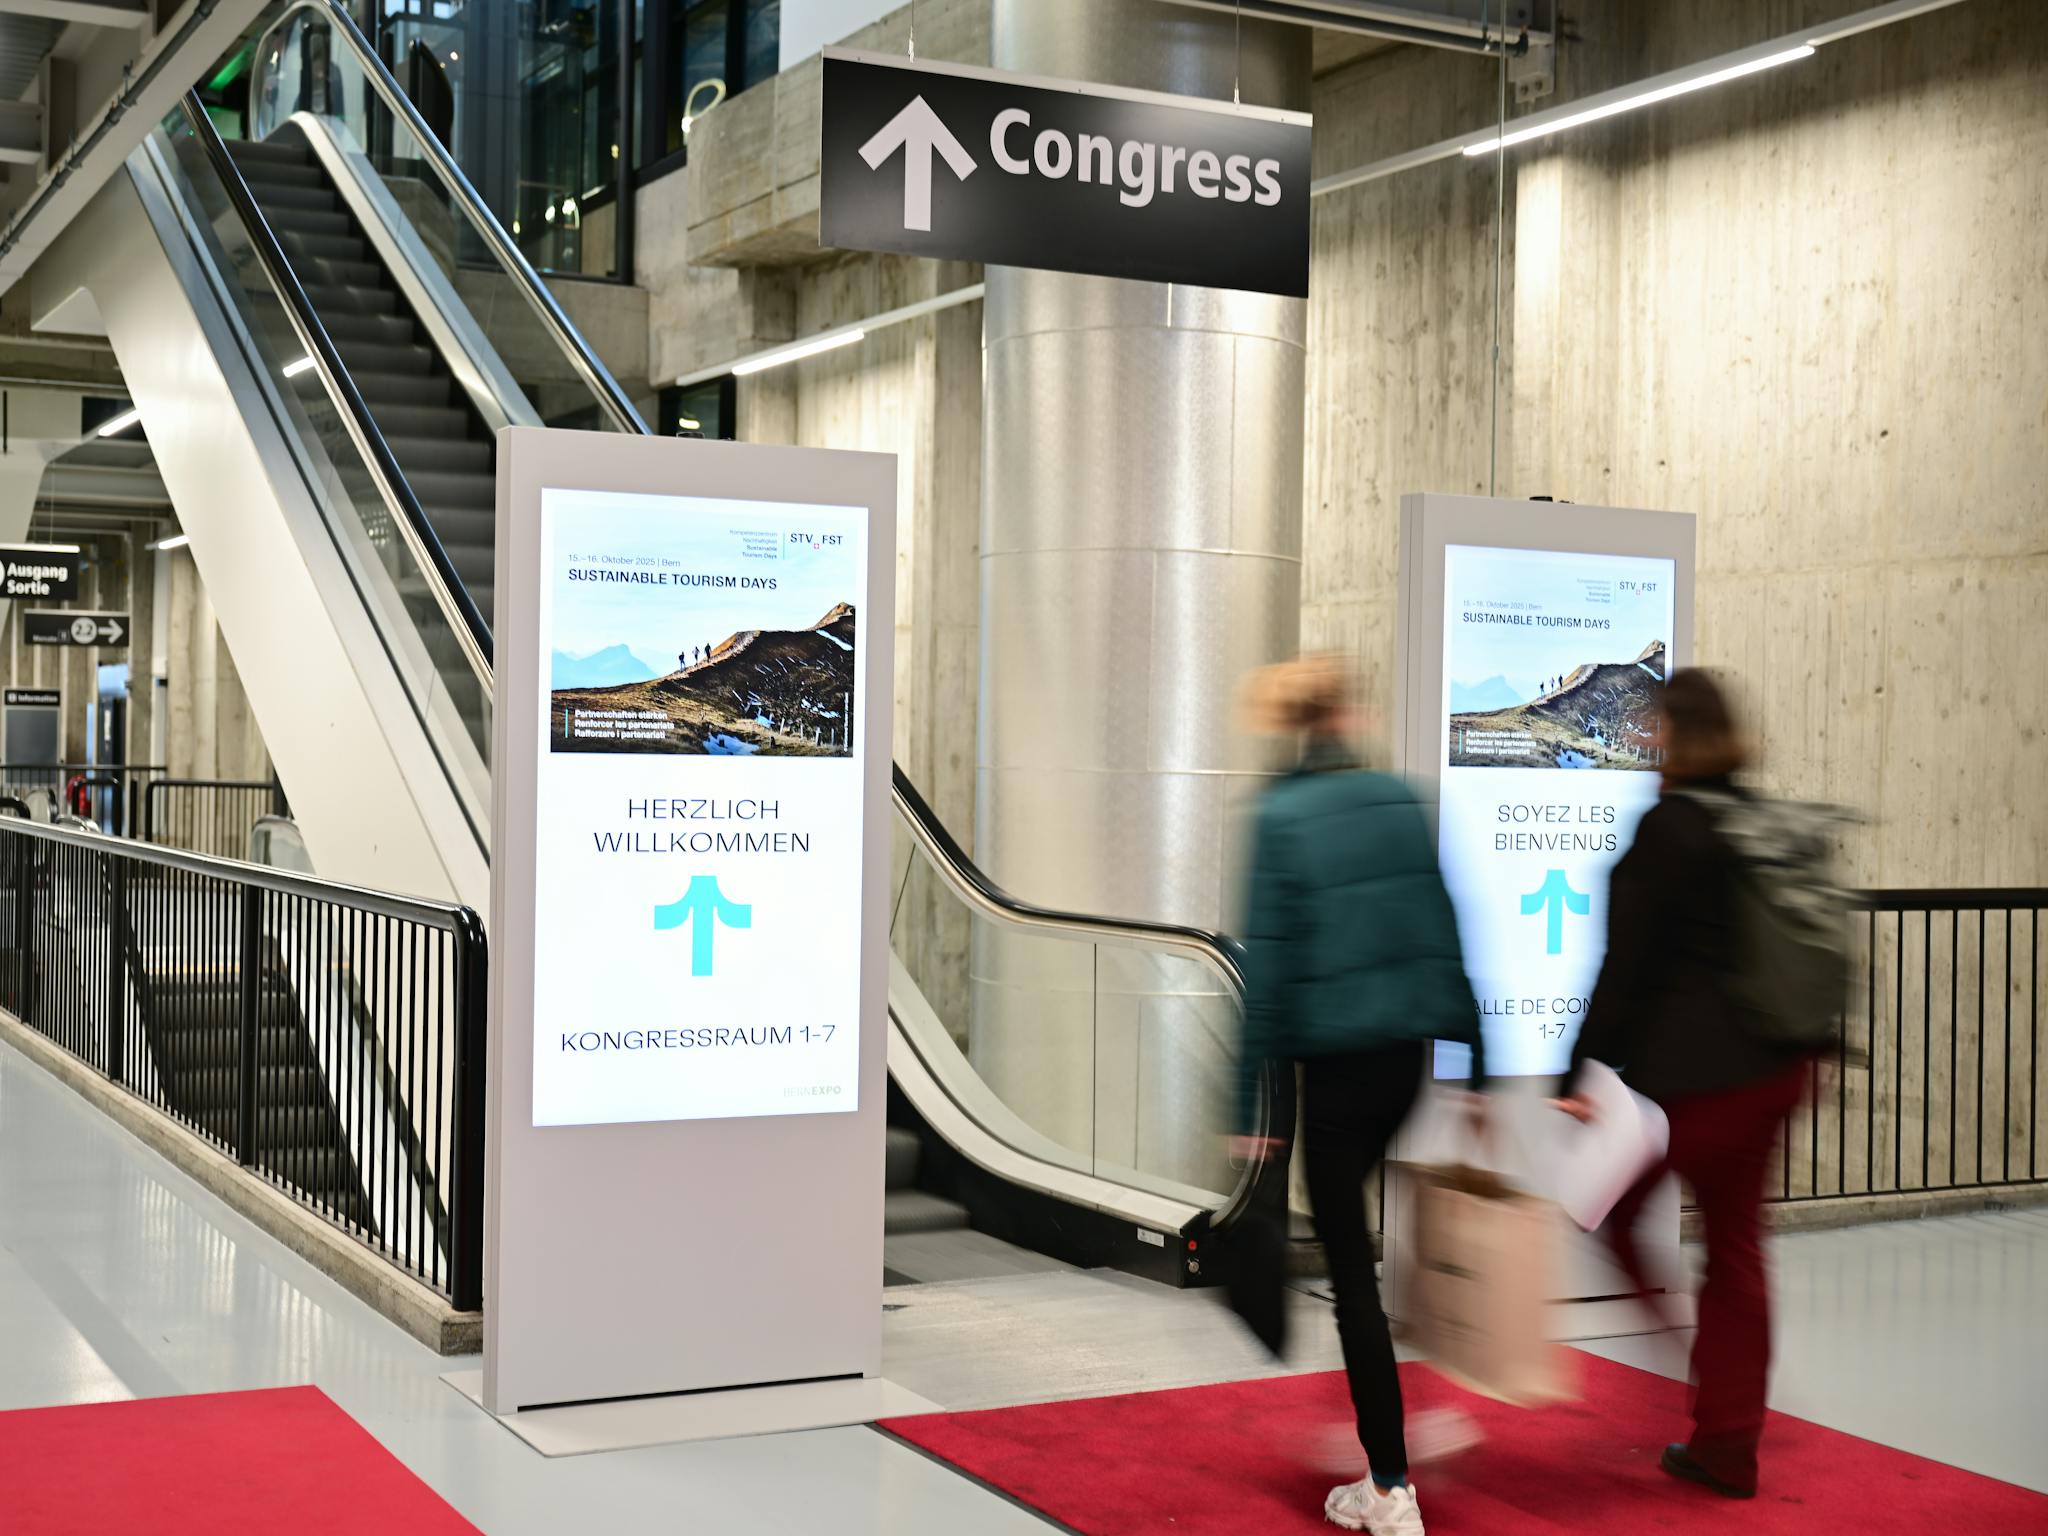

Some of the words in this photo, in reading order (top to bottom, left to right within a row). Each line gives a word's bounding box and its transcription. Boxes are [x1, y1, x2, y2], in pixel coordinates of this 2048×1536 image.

[989, 107, 1282, 208] Congress
[790, 533, 814, 543] STV
[822, 535, 844, 545] FST
[601, 555, 634, 565] Oktober
[635, 557, 656, 566] 2025
[661, 558, 681, 567] Bern
[7, 561, 68, 582] Ausgang
[568, 568, 668, 585] SUSTAINABLE
[671, 573, 736, 588] TOURISM
[740, 577, 777, 590] DAYS
[7, 579, 50, 596] Sortie
[1619, 581, 1636, 590] STV
[1641, 582, 1657, 591] FST
[1463, 612, 1533, 625] SUSTAINABLE
[1535, 616, 1582, 628] TOURISM
[1584, 618, 1610, 630] DAYS
[575, 709, 637, 719] Partnerschaften
[575, 719, 614, 728] Renforcer
[628, 798, 780, 820] HERZLICH
[1497, 804, 1571, 823] SOYEZ
[1578, 805, 1616, 824] LES
[593, 832, 811, 853] WILLKOMMEN
[1495, 833, 1618, 852] BIENVENUS
[1474, 999, 1515, 1015] ALLE
[1521, 999, 1546, 1015] DE
[1551, 997, 1592, 1014] CON
[561, 1025, 792, 1052] KONGRESSRAUM
[799, 1024, 836, 1044] 1-7
[1538, 1023, 1566, 1040] 1-7
